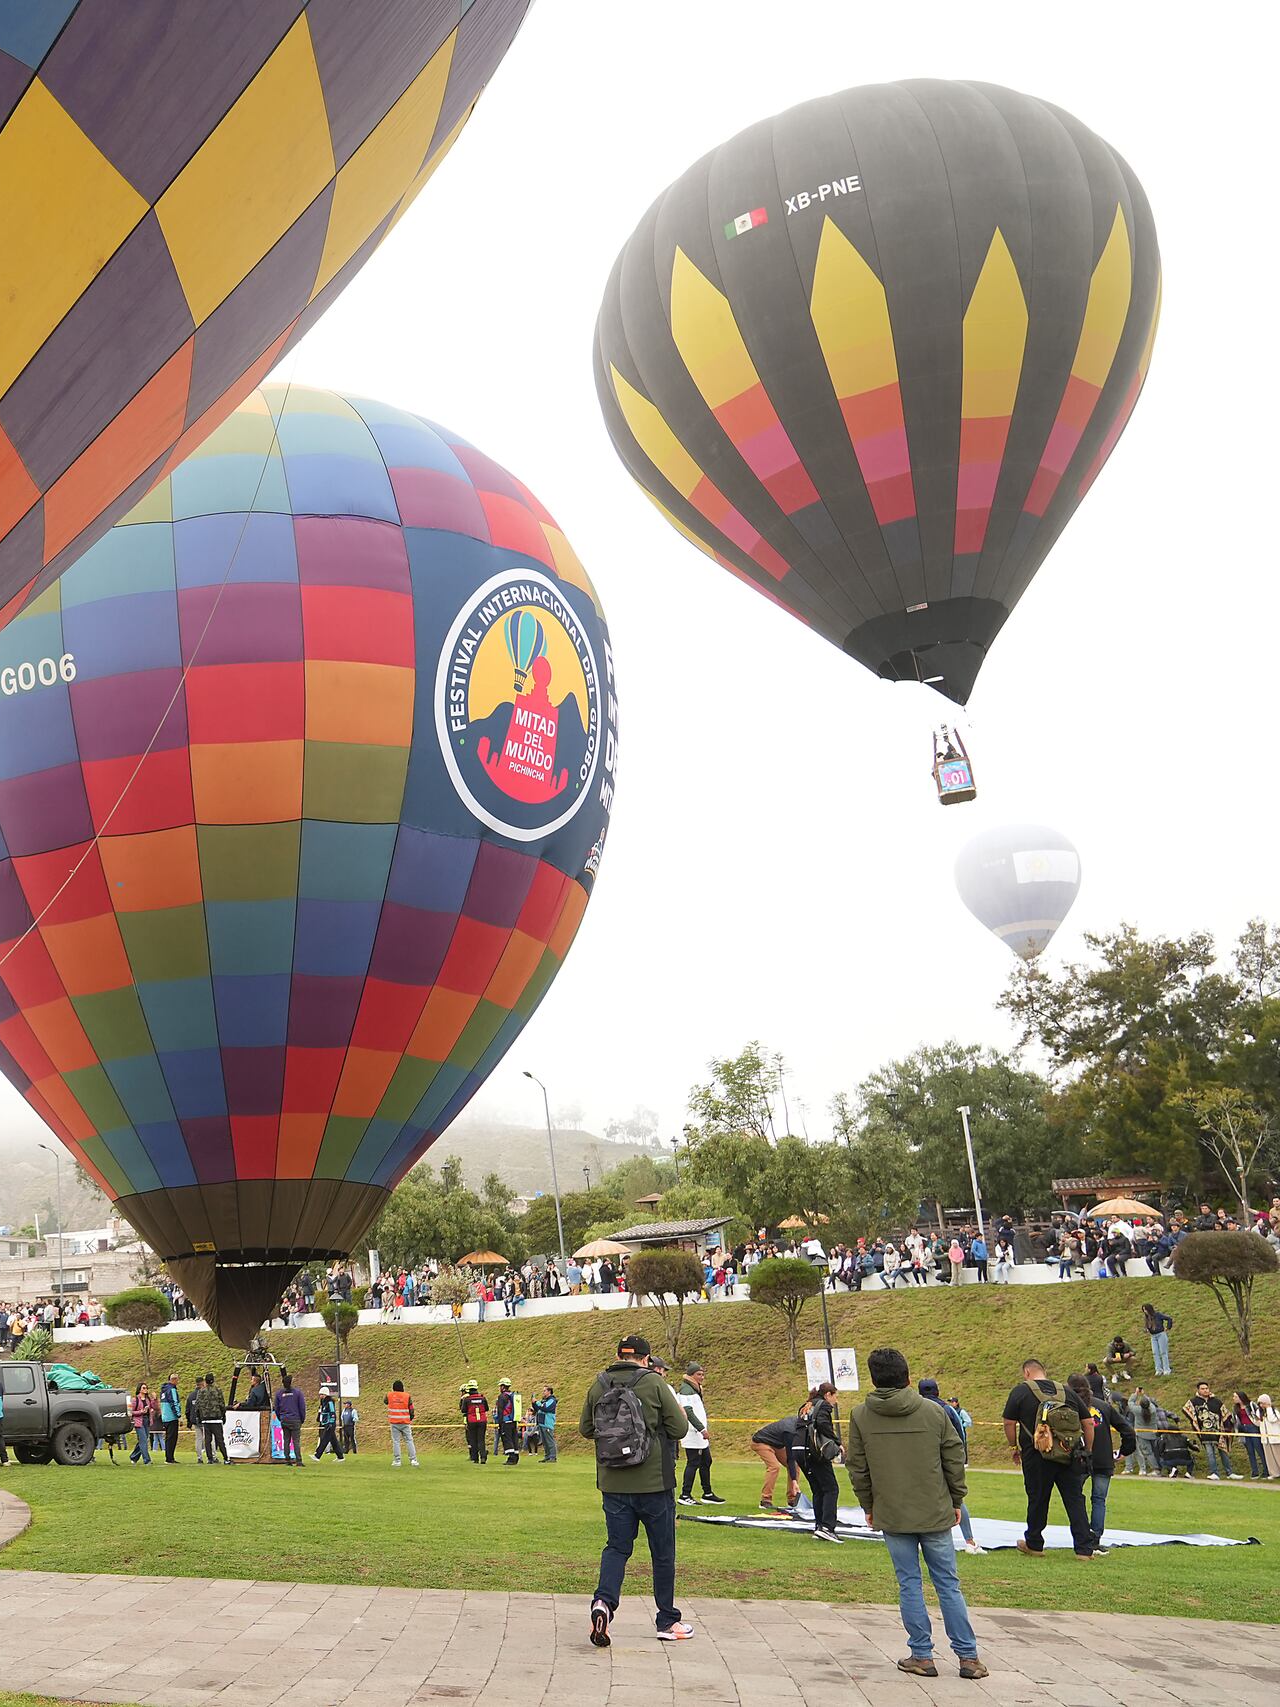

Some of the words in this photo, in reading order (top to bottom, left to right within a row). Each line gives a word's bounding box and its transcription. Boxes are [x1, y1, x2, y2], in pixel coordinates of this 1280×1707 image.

[784, 175, 862, 216] XB-PNE
[477, 584, 582, 653] INTERNACIONAL
[451, 624, 482, 732] FESTIVAL
[581, 655, 595, 699] DEL
[515, 707, 556, 738] MITAD
[523, 730, 544, 750] DEL
[505, 740, 553, 771] MUNDO
[580, 707, 597, 781] GLOBO
[508, 761, 545, 782] PICHINCHA
[951, 771, 965, 785] 01
